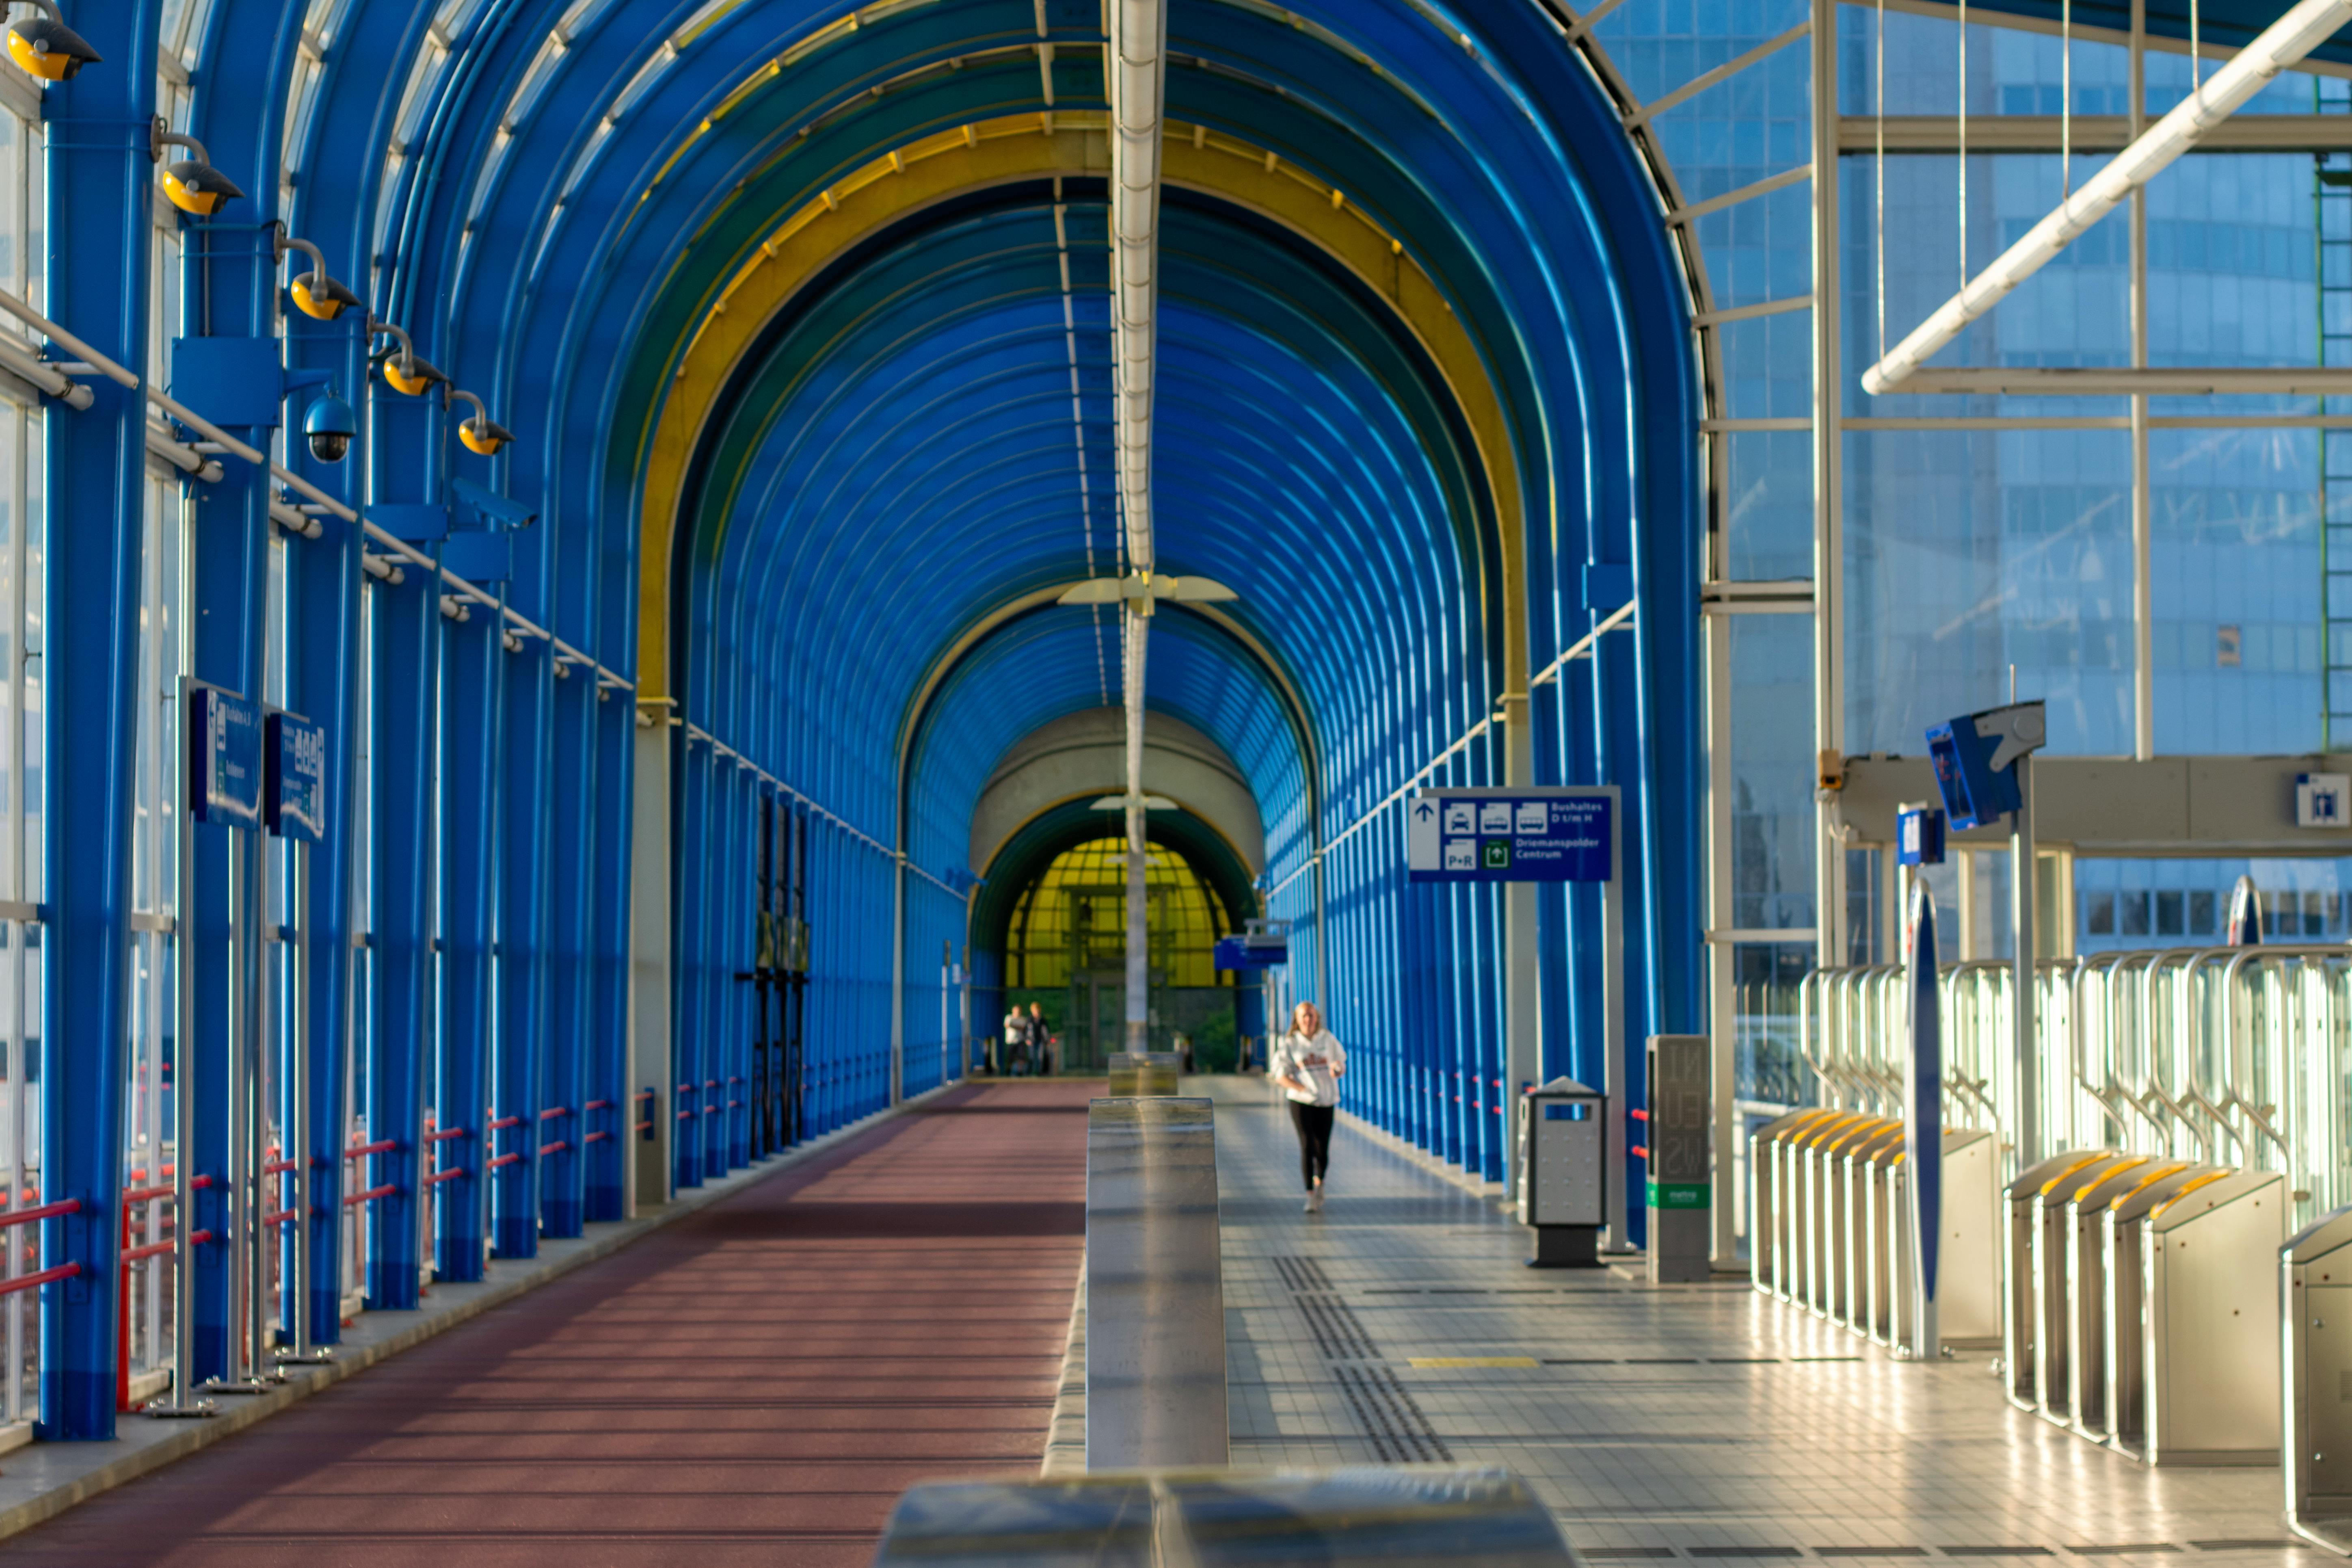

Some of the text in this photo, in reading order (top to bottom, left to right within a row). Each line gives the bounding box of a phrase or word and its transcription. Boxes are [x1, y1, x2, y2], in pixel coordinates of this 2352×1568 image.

[1552, 802, 1602, 811] Bushaltes
[1552, 814, 1560, 822] D
[1585, 814, 1592, 822] H
[1516, 838, 1599, 849] Driemanspolder
[1516, 850, 1561, 859] Centrum
